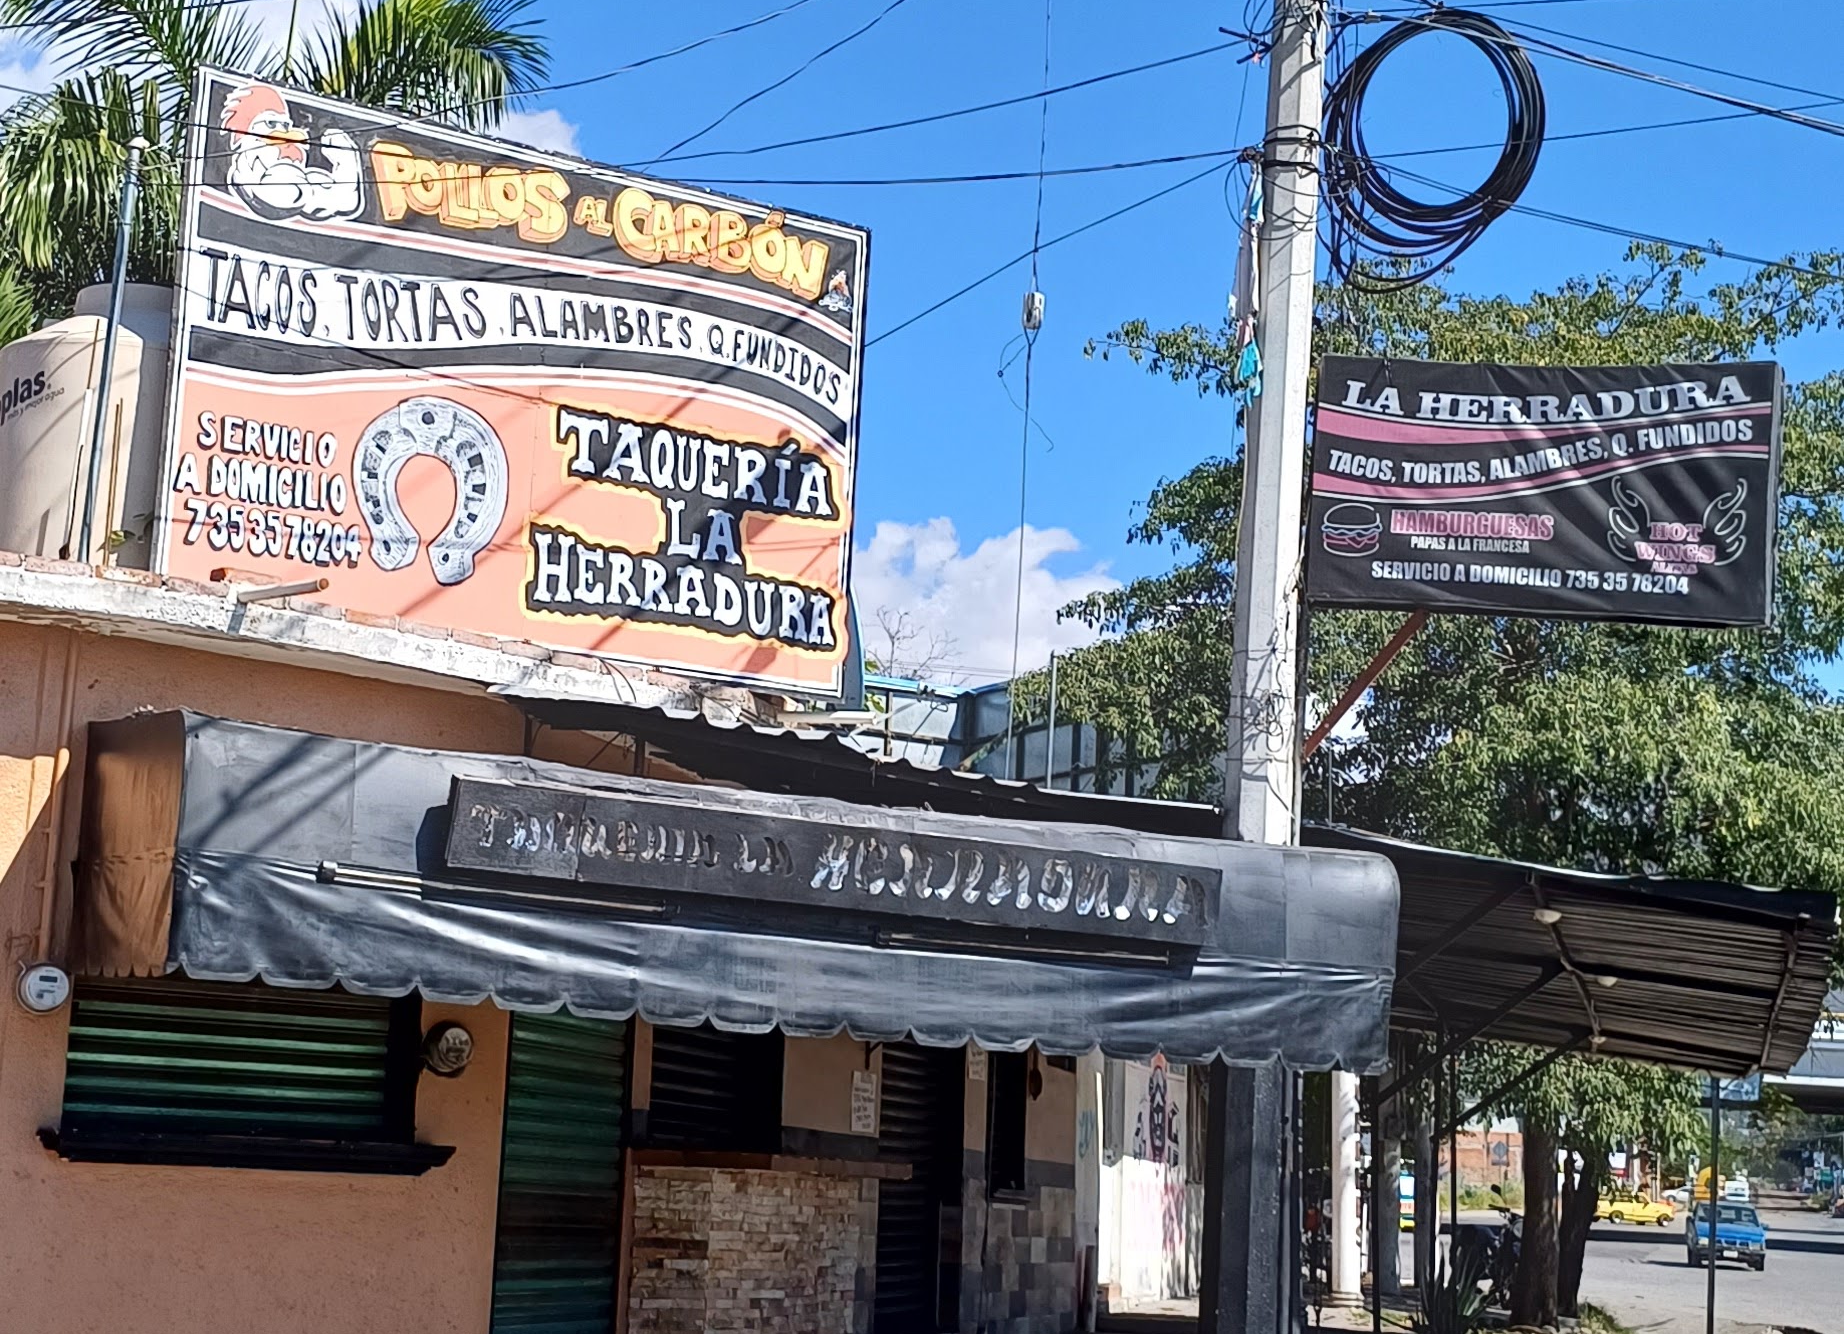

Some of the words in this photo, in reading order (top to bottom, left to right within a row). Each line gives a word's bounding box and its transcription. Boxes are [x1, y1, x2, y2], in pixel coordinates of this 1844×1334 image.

[368, 140, 570, 244] POLLOS
[574, 195, 613, 237] AL
[612, 187, 829, 301] CARBÓN
[1341, 380, 1404, 416] LA
[1416, 375, 1751, 424] HERRADURA
[197, 410, 338, 468] SERVICIO
[559, 409, 833, 517] TAQUERÍA
[1329, 449, 1397, 483] TACOS,
[1401, 461, 1486, 484] TORTAS,
[1489, 437, 1608, 481] ALAMBRES,
[1611, 431, 1634, 457] Q.
[1637, 419, 1753, 451] FUNDIDOS
[173, 452, 202, 496] A
[206, 454, 347, 516] DOMICILIO
[665, 497, 743, 566] LA
[1391, 509, 1555, 540] HAMBURGUESAS
[1411, 535, 1446, 550] PAPAS
[1447, 538, 1456, 550] A
[1457, 538, 1472, 552] LA
[1472, 539, 1530, 554] FRANCESA
[1634, 541, 1716, 563] WINGS
[1649, 521, 1703, 543] HOT
[533, 531, 836, 647] HERRADURA
[1371, 561, 1451, 582] SERVICIO
[1454, 563, 1466, 582] A
[1469, 565, 1562, 588] DOMICILIO
[1565, 569, 1600, 589] 735
[1602, 571, 1628, 592] 35
[1631, 573, 1690, 596] 78204
